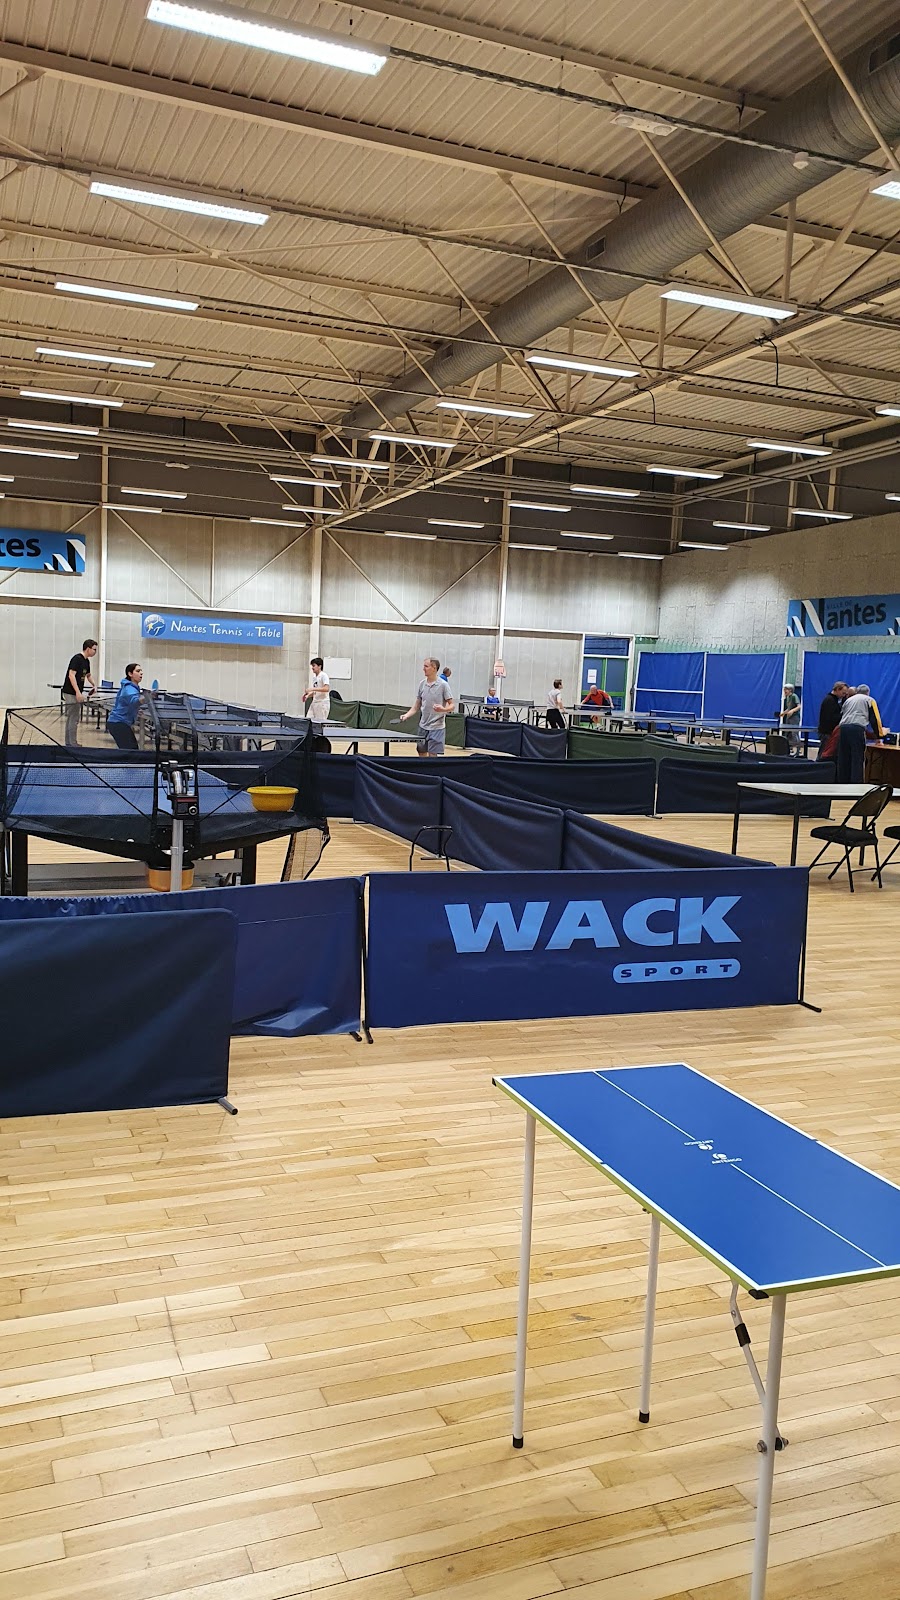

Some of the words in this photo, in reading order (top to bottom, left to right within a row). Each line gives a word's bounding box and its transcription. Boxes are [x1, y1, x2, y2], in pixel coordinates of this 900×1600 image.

[170, 620, 207, 634] Nantes
[208, 623, 243, 637] Tennis
[254, 626, 281, 638] Table
[443, 895, 742, 954] WACK
[620, 963, 734, 979] SPORT
